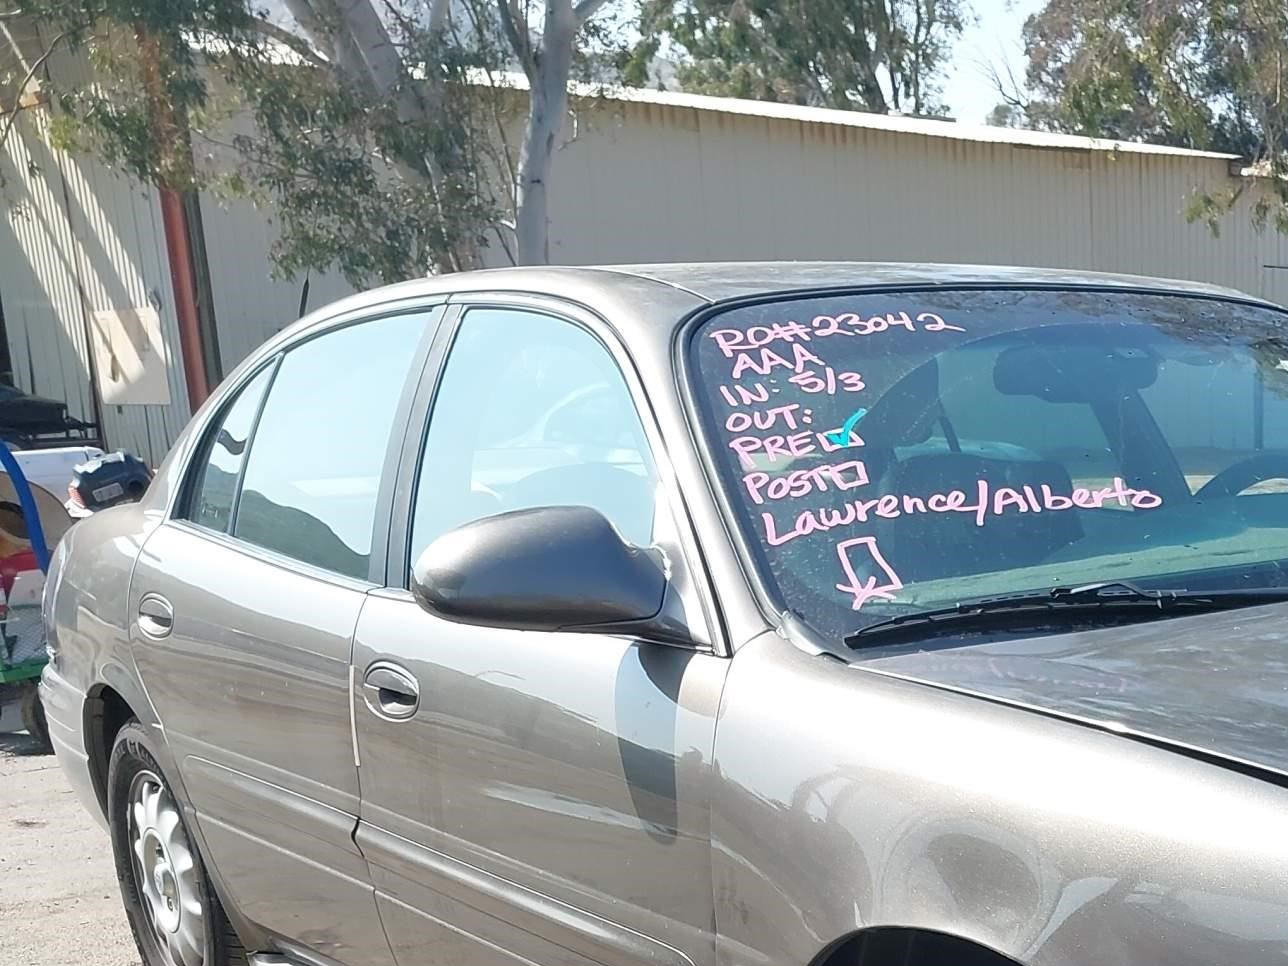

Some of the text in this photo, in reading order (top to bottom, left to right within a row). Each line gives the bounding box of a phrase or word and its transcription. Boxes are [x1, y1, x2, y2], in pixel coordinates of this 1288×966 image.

[731, 341, 826, 379] AAA
[719, 366, 866, 407] IN: 5/3
[725, 404, 813, 434] OUT:
[742, 468, 830, 505] POST
[762, 478, 1163, 546] Lawrence/Alberto
